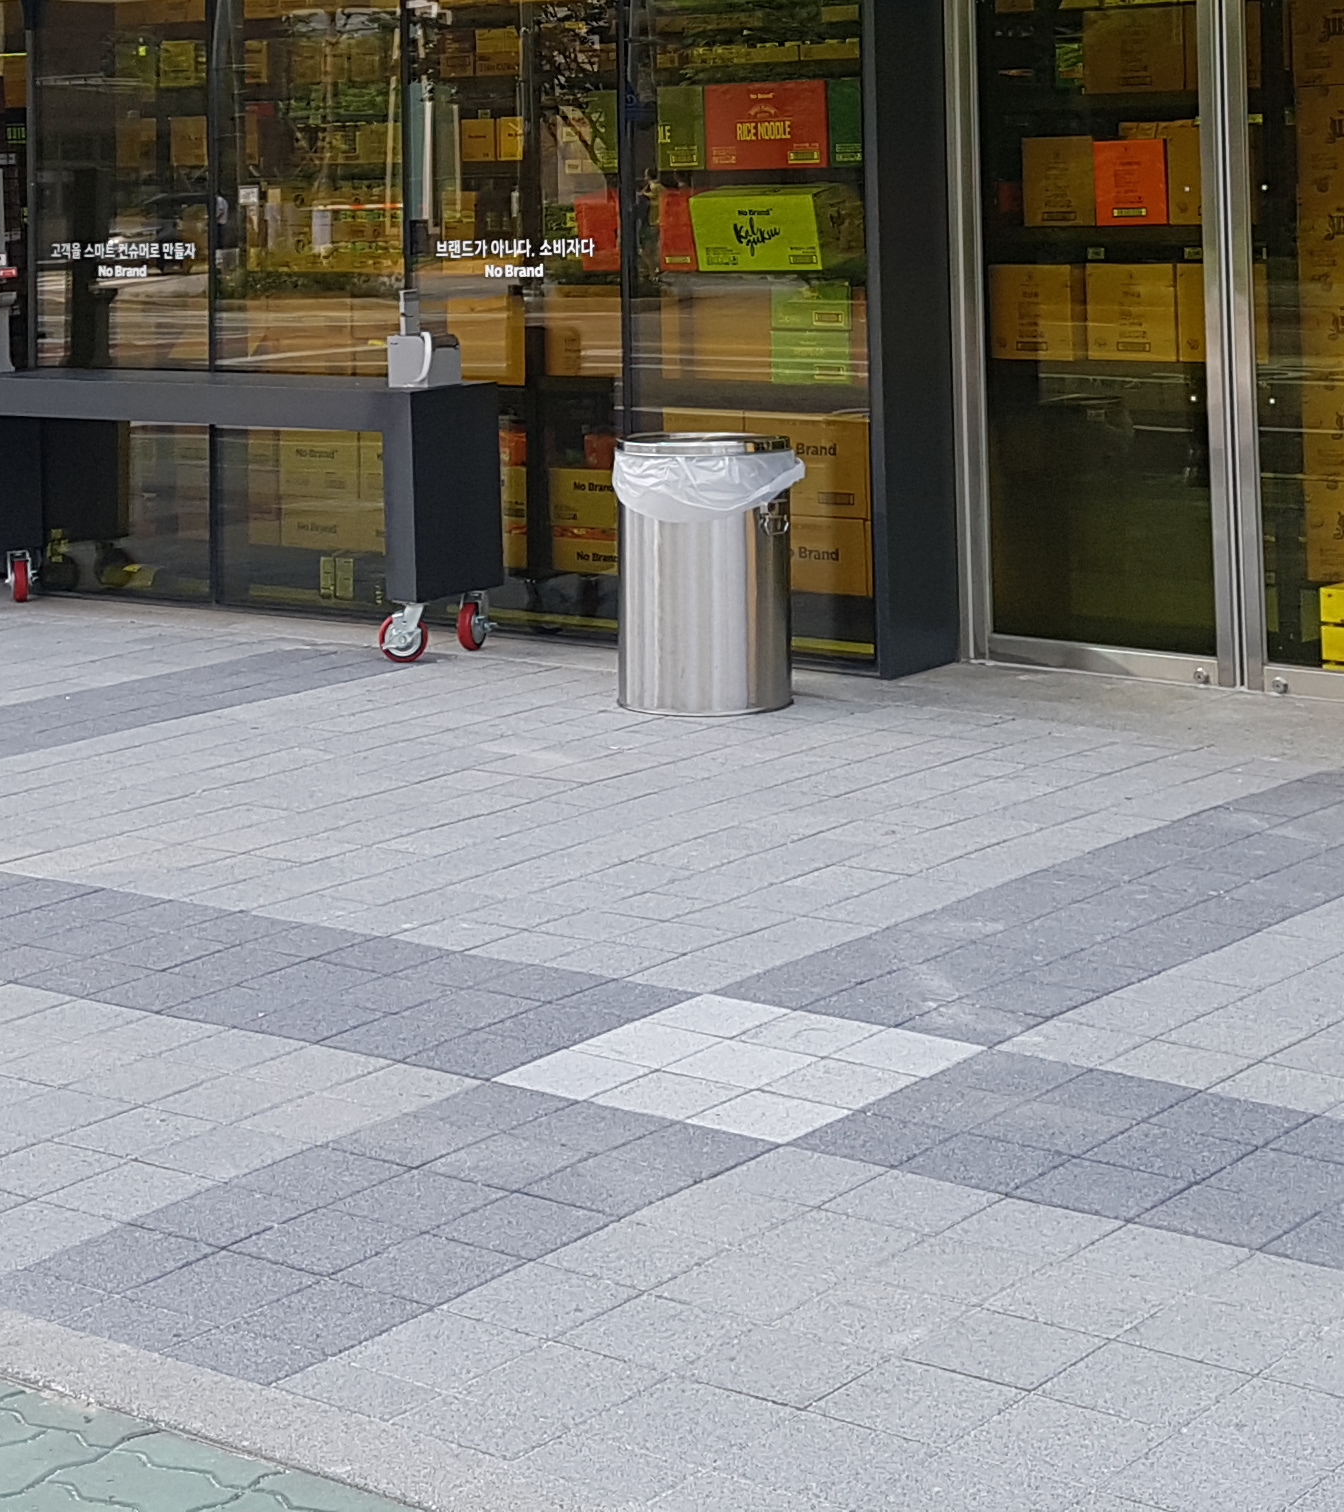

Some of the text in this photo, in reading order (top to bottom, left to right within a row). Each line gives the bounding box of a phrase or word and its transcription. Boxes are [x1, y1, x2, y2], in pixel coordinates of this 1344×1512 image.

[736, 120, 792, 141] RICE NOODLE
[50, 242, 197, 260] 고객을 스마트 컨슈머로 만들자
[435, 237, 596, 259] 브랜드가 아니다. 소비자다
[97, 264, 149, 278] No Brand
[484, 263, 545, 278] No Brand
[795, 442, 838, 456] Brand
[573, 481, 586, 491] No
[576, 551, 590, 561] No
[798, 546, 840, 563] Brand
